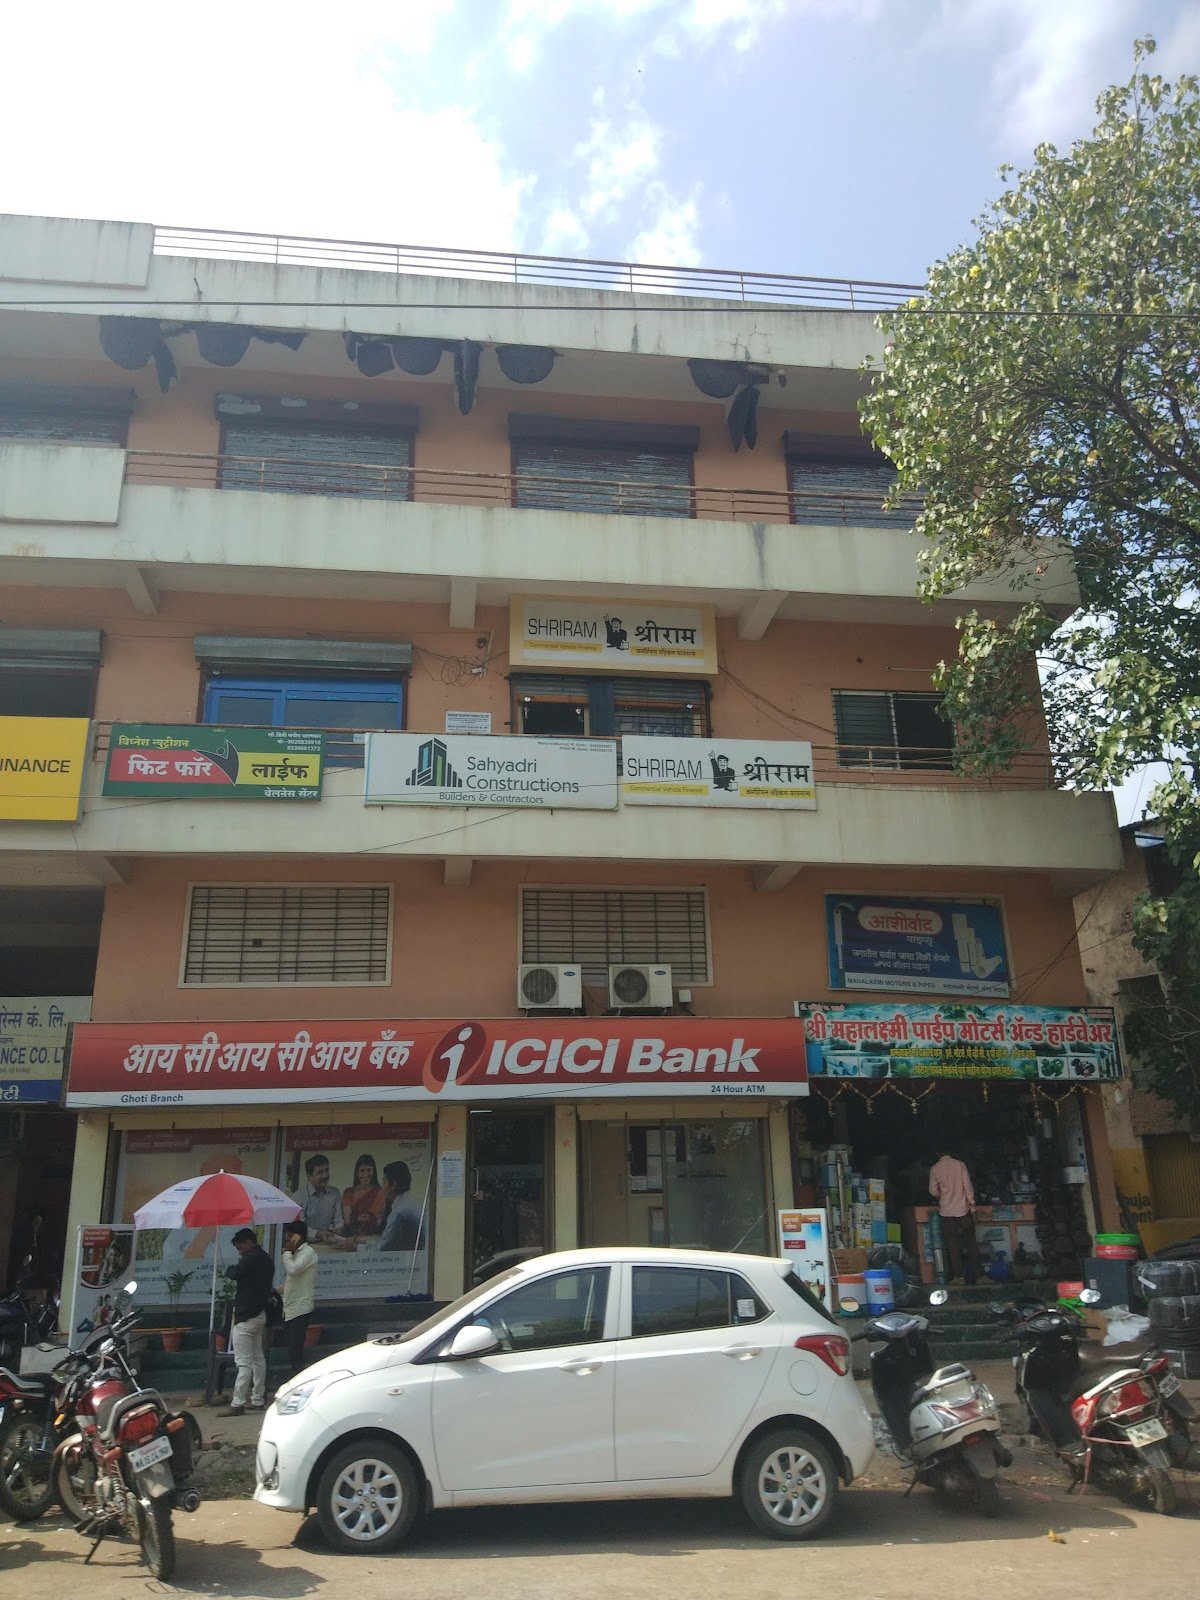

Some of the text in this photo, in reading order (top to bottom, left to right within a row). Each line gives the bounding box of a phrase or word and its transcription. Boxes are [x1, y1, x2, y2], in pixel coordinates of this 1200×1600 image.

[528, 618, 597, 639] SHRIRAM
[634, 620, 696, 645] श्रीराम
[128, 754, 213, 777] फिट फॉर
[251, 757, 309, 781] लाईफ
[467, 756, 537, 774] Sahyadri
[627, 757, 702, 779] SHRIRAM
[743, 756, 810, 783] श्रीराम
[466, 774, 580, 793] Constructions
[629, 784, 703, 794] Commercial Vehicle Finance
[439, 792, 544, 804] Builders & Contractors
[869, 911, 933, 932] आशीर्वाद
[847, 977, 884, 986] MAHALAXMI
[884, 978, 912, 987] MOTORS
[917, 980, 936, 988] PIPES
[27, 1005, 42, 1027] कं.
[49, 1004, 67, 1027] लि.
[806, 1012, 827, 1039] श्री
[830, 1014, 909, 1043] महालक्ष्मी
[911, 1013, 955, 1043] पाईप
[958, 1014, 1005, 1041] मोटर्स
[1045, 1016, 1113, 1045] हार्डवेअर
[29, 1047, 50, 1064] CO.
[123, 1043, 182, 1074] आय
[182, 1031, 220, 1073] सी
[368, 1029, 414, 1070] बँक
[485, 1038, 620, 1076] ICICI
[626, 1038, 761, 1074] Bank
[120, 1093, 184, 1104] Ghoti Branch
[711, 1084, 765, 1093] 24 Hour ATM
